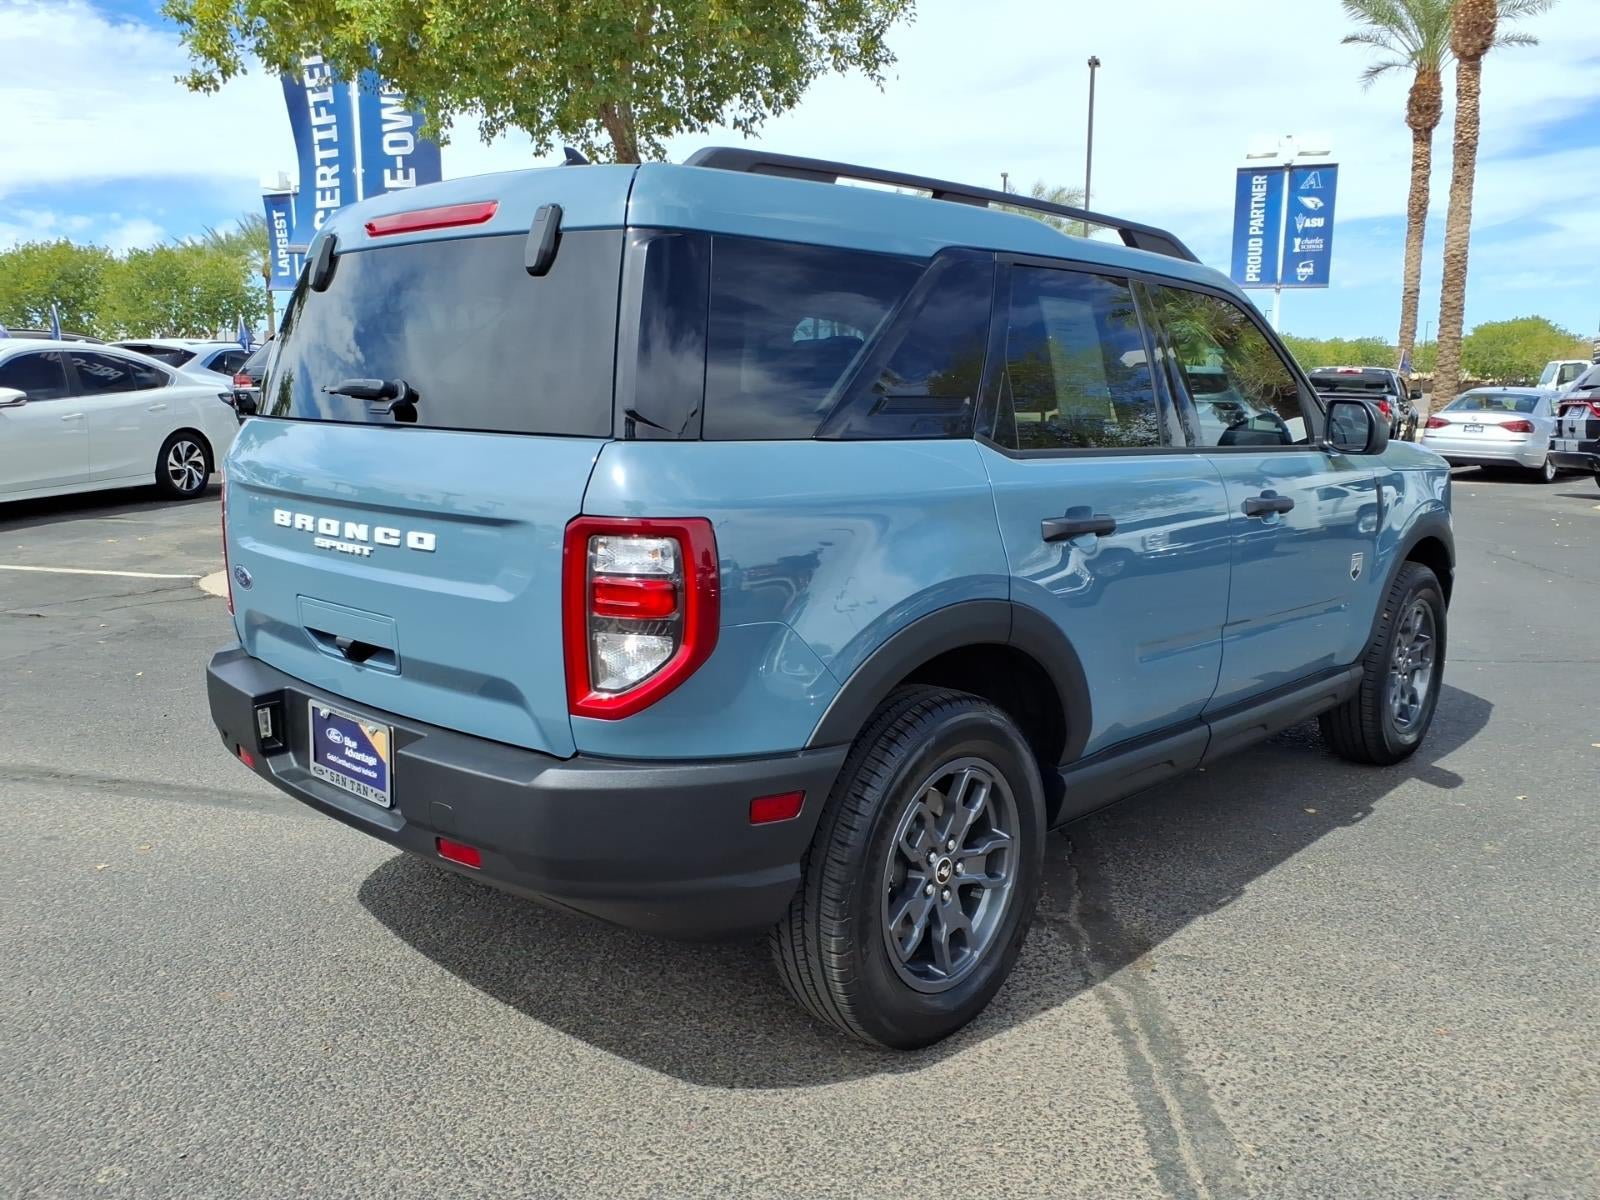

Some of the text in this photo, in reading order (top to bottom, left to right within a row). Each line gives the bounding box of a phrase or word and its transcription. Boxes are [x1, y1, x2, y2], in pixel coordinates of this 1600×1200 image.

[1246, 175, 1268, 282] PROUD PARTNER
[1304, 217, 1325, 228] ASU
[272, 209, 290, 276] LARGEST
[273, 508, 436, 551] BRONCO
[314, 537, 374, 556] SPORT
[344, 736, 358, 749] Blue
[345, 747, 378, 767] Advantage
[330, 772, 369, 797] SAN TAN
